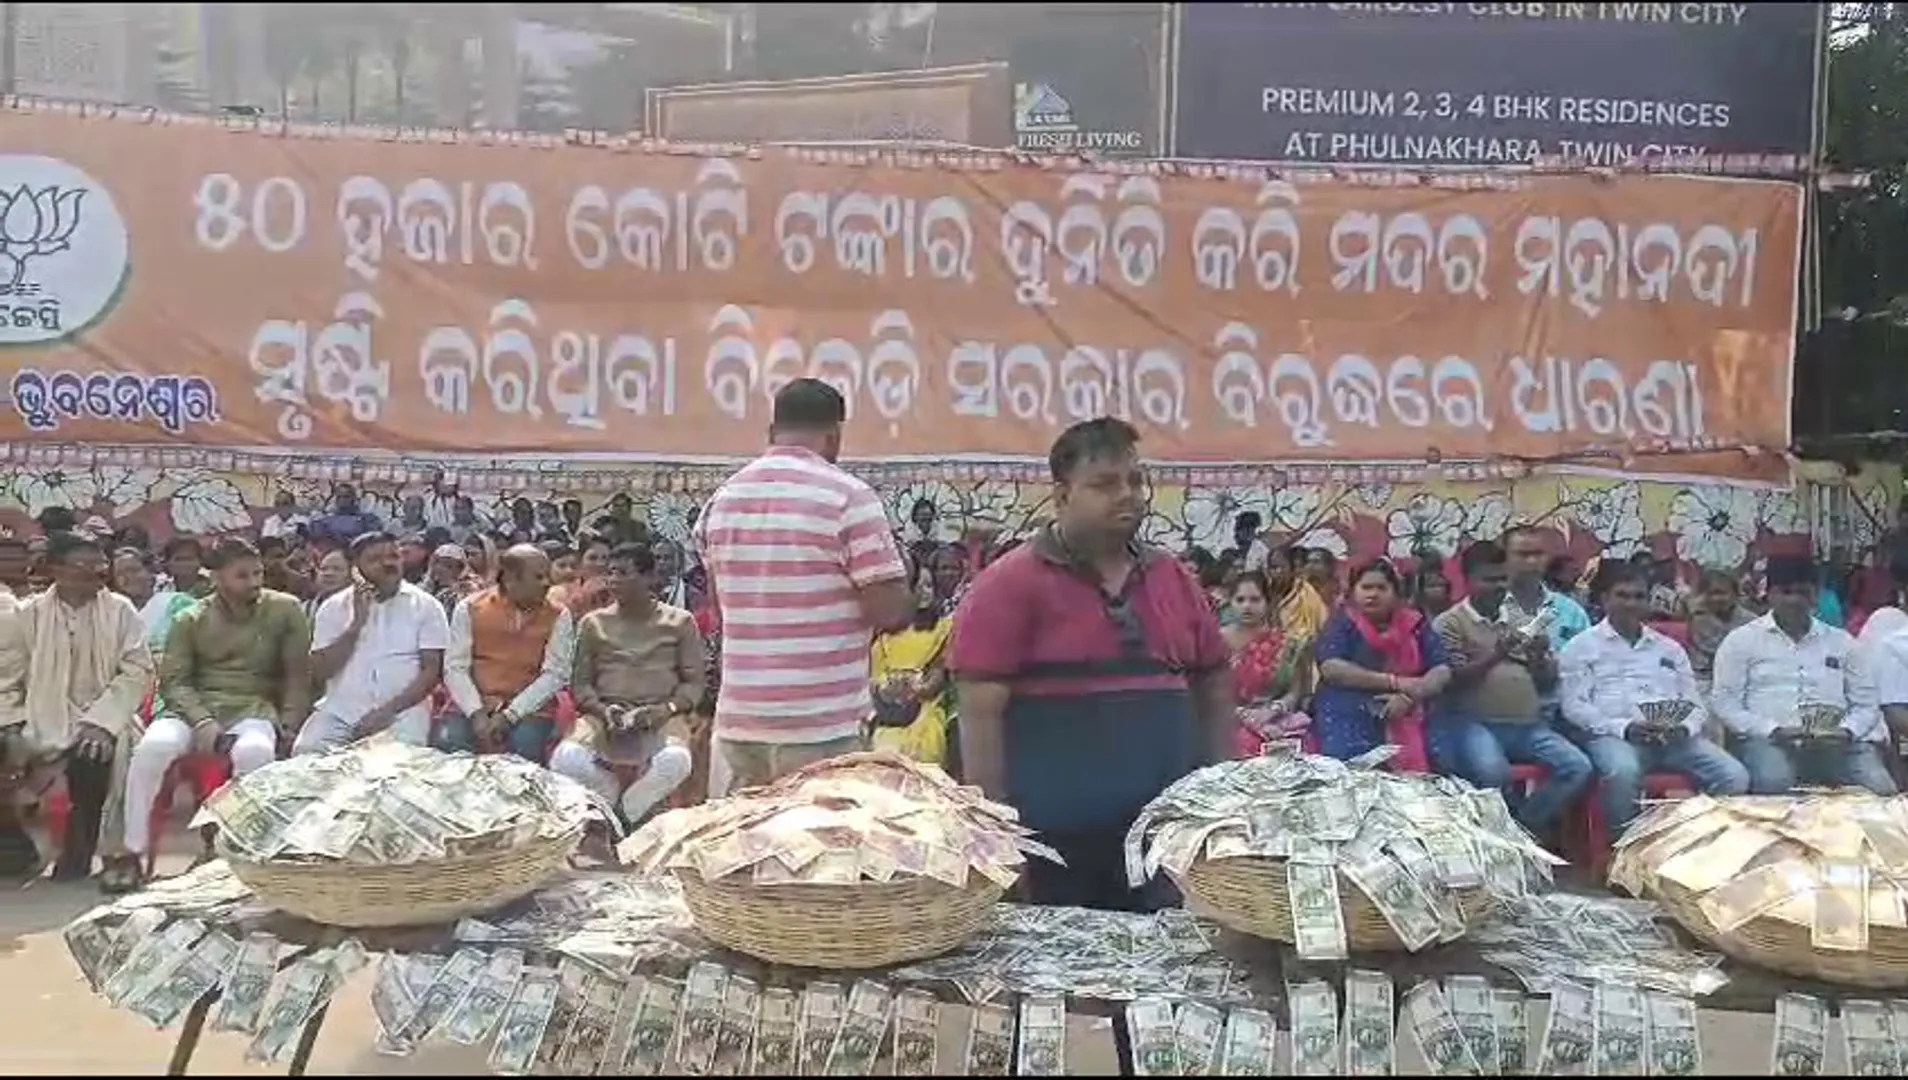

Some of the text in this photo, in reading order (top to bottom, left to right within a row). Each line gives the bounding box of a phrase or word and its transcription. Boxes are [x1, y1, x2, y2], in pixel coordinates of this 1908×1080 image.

[1556, 3, 1584, 19] IN
[1600, 3, 1671, 22] TWIN
[1680, 3, 1747, 25] CITY
[1262, 88, 1731, 127] PREMIUM 2, 3, 4 BHK RESIDENCES
[1076, 131, 1142, 147] LIVING
[1284, 132, 1323, 157] AT
[1559, 139, 1633, 165] TWIN
[194, 173, 305, 252] ୫୦
[337, 174, 540, 282] ହଜାର
[565, 157, 748, 271] କୋଟି
[775, 190, 976, 284] ଟଙ୍କାର
[1192, 180, 1303, 299] କରି
[1329, 209, 1491, 301] ମଦର
[1514, 215, 1758, 318] ମହାନଦୀ
[249, 291, 391, 440] ସୃଷ୍ଟି
[419, 298, 676, 430] କରିଥିବା
[948, 340, 1191, 430] ସରକାର
[1212, 322, 1494, 447] ବିରୁଦ୍ଧରେ
[1509, 356, 1706, 439] ଧାରଣା
